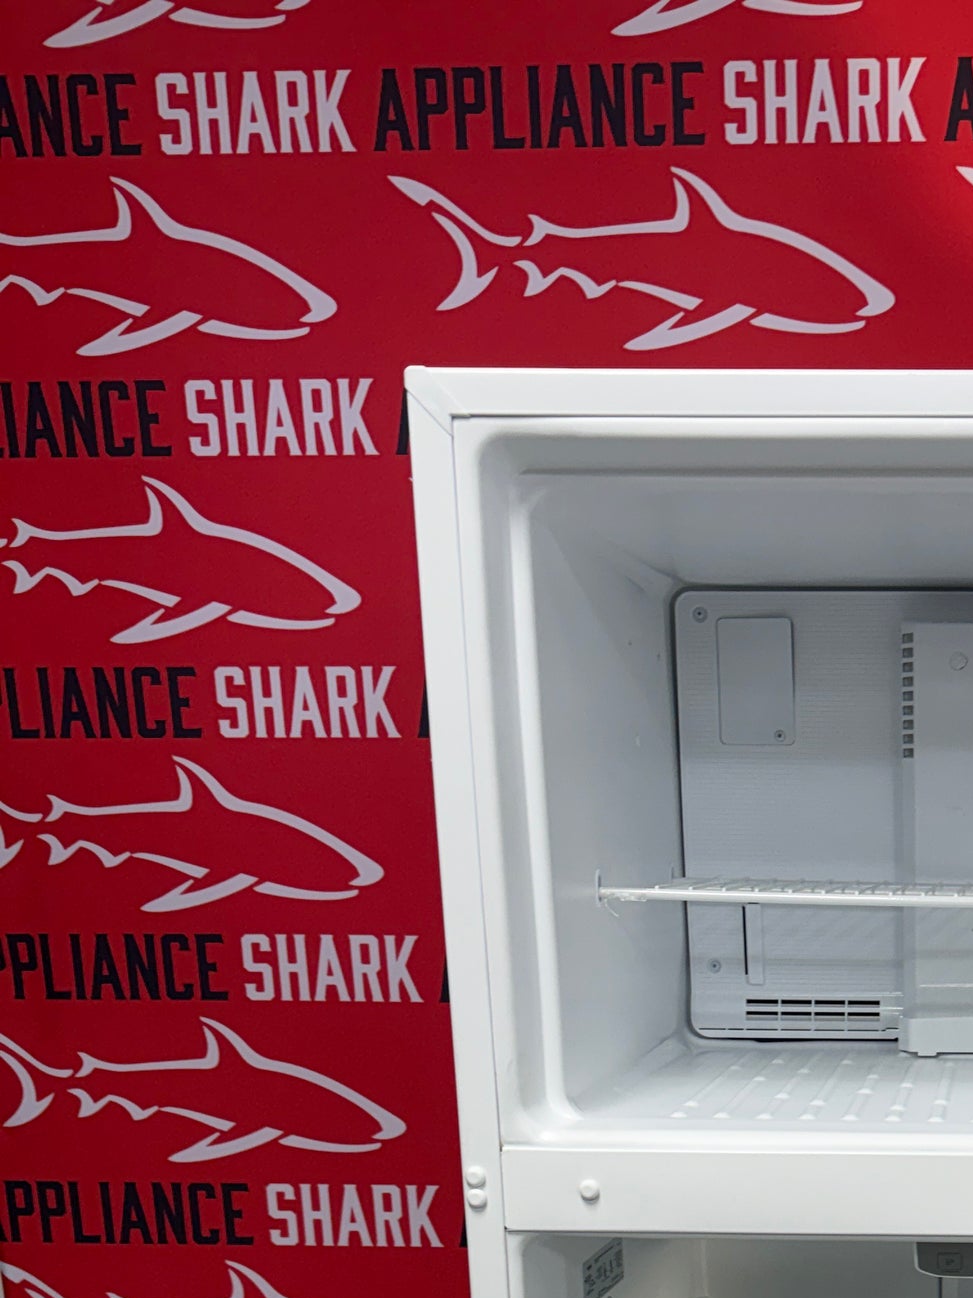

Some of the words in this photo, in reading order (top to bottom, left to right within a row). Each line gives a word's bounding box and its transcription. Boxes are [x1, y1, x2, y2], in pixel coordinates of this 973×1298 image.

[156, 70, 356, 154] SHARK
[374, 62, 705, 151] APPLIANCE
[724, 57, 926, 144] SHARK
[0, 380, 172, 458] IANCE
[185, 378, 378, 456] SHARK
[214, 666, 400, 738] SHARK
[0, 933, 228, 1001] PLIANCE
[241, 934, 423, 1002] SHARK
[0, 1180, 254, 1245] PPLIANCE
[266, 1184, 443, 1247] SHARK
